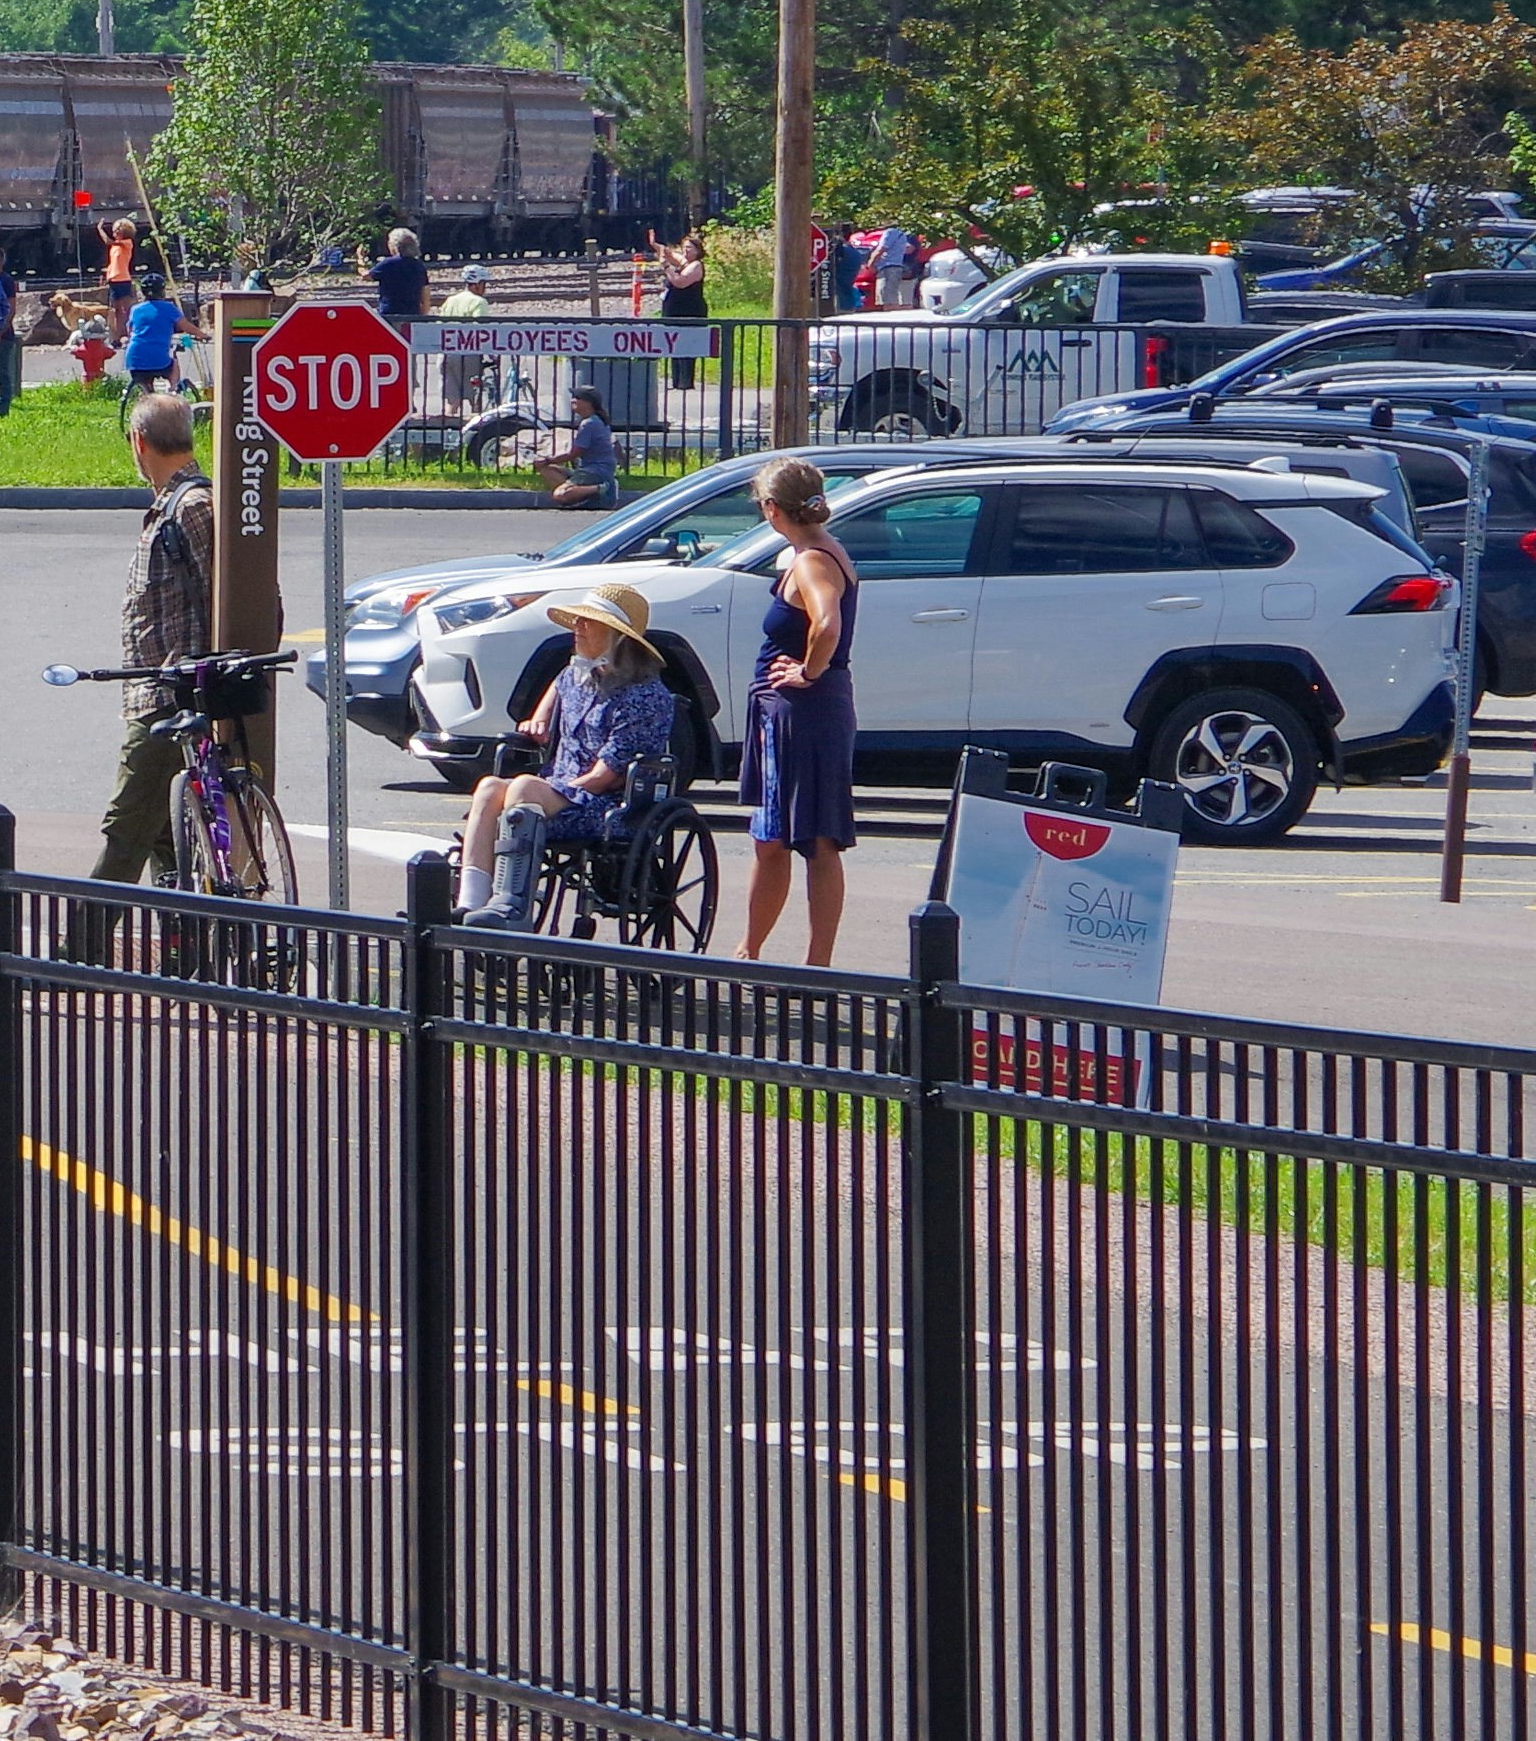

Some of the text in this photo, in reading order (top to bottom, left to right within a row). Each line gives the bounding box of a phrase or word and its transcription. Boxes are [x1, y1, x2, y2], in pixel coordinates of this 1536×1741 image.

[442, 329, 680, 355] EMPLOYEES ONLY
[265, 353, 401, 412] STOP
[241, 447, 269, 538] Street
[1045, 828, 1088, 847] red
[1065, 881, 1148, 926] SAIL
[1064, 913, 1147, 946] TODAY!
[154, 1420, 1269, 1477] STOP
